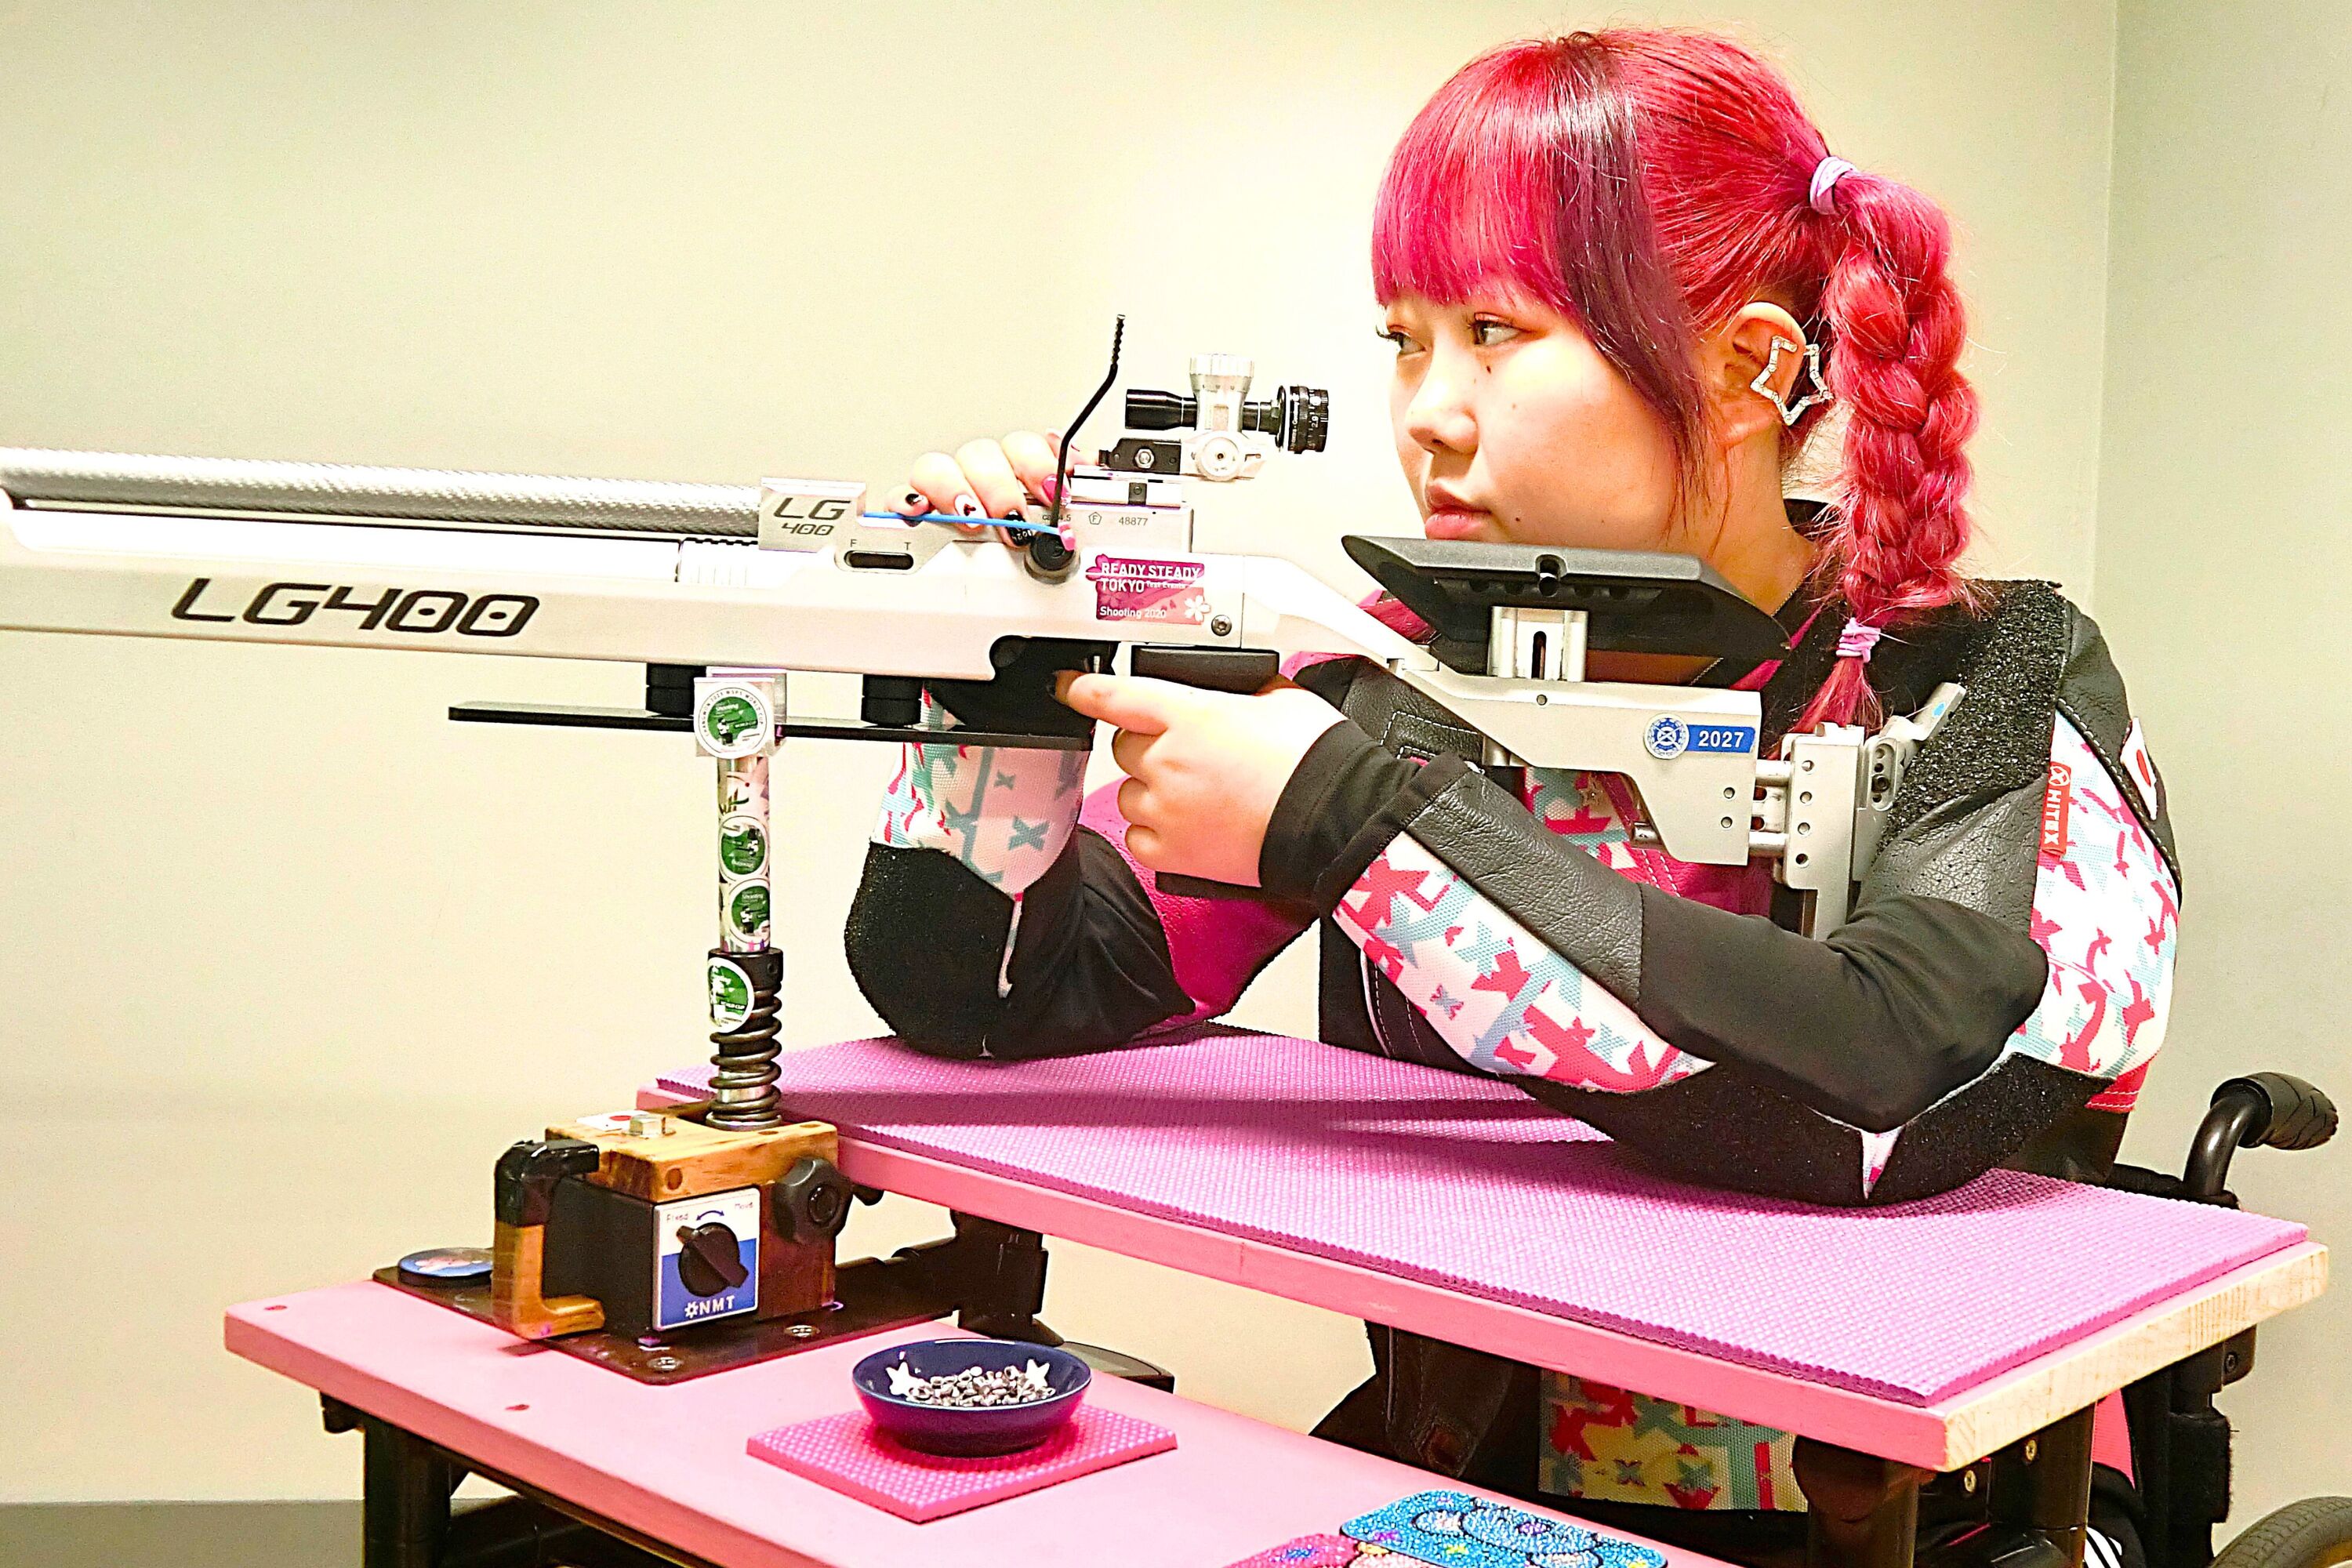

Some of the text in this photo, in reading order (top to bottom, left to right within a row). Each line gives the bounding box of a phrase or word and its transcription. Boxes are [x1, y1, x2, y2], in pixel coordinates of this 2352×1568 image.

[773, 497, 851, 521] LG
[782, 522, 834, 535] 400
[1118, 516, 1149, 526] 48877
[850, 539, 857, 547] F
[904, 542, 911, 550] T
[1101, 562, 1201, 579] READY STEADY
[1100, 578, 1145, 593] TOKYO
[170, 577, 540, 637] LG400
[1099, 606, 1167, 619] Shooting 2020
[1698, 730, 1744, 747] 2027
[2044, 789, 2062, 845] HITEX
[666, 1213, 689, 1224] Fixed
[699, 1295, 735, 1316] NMT
